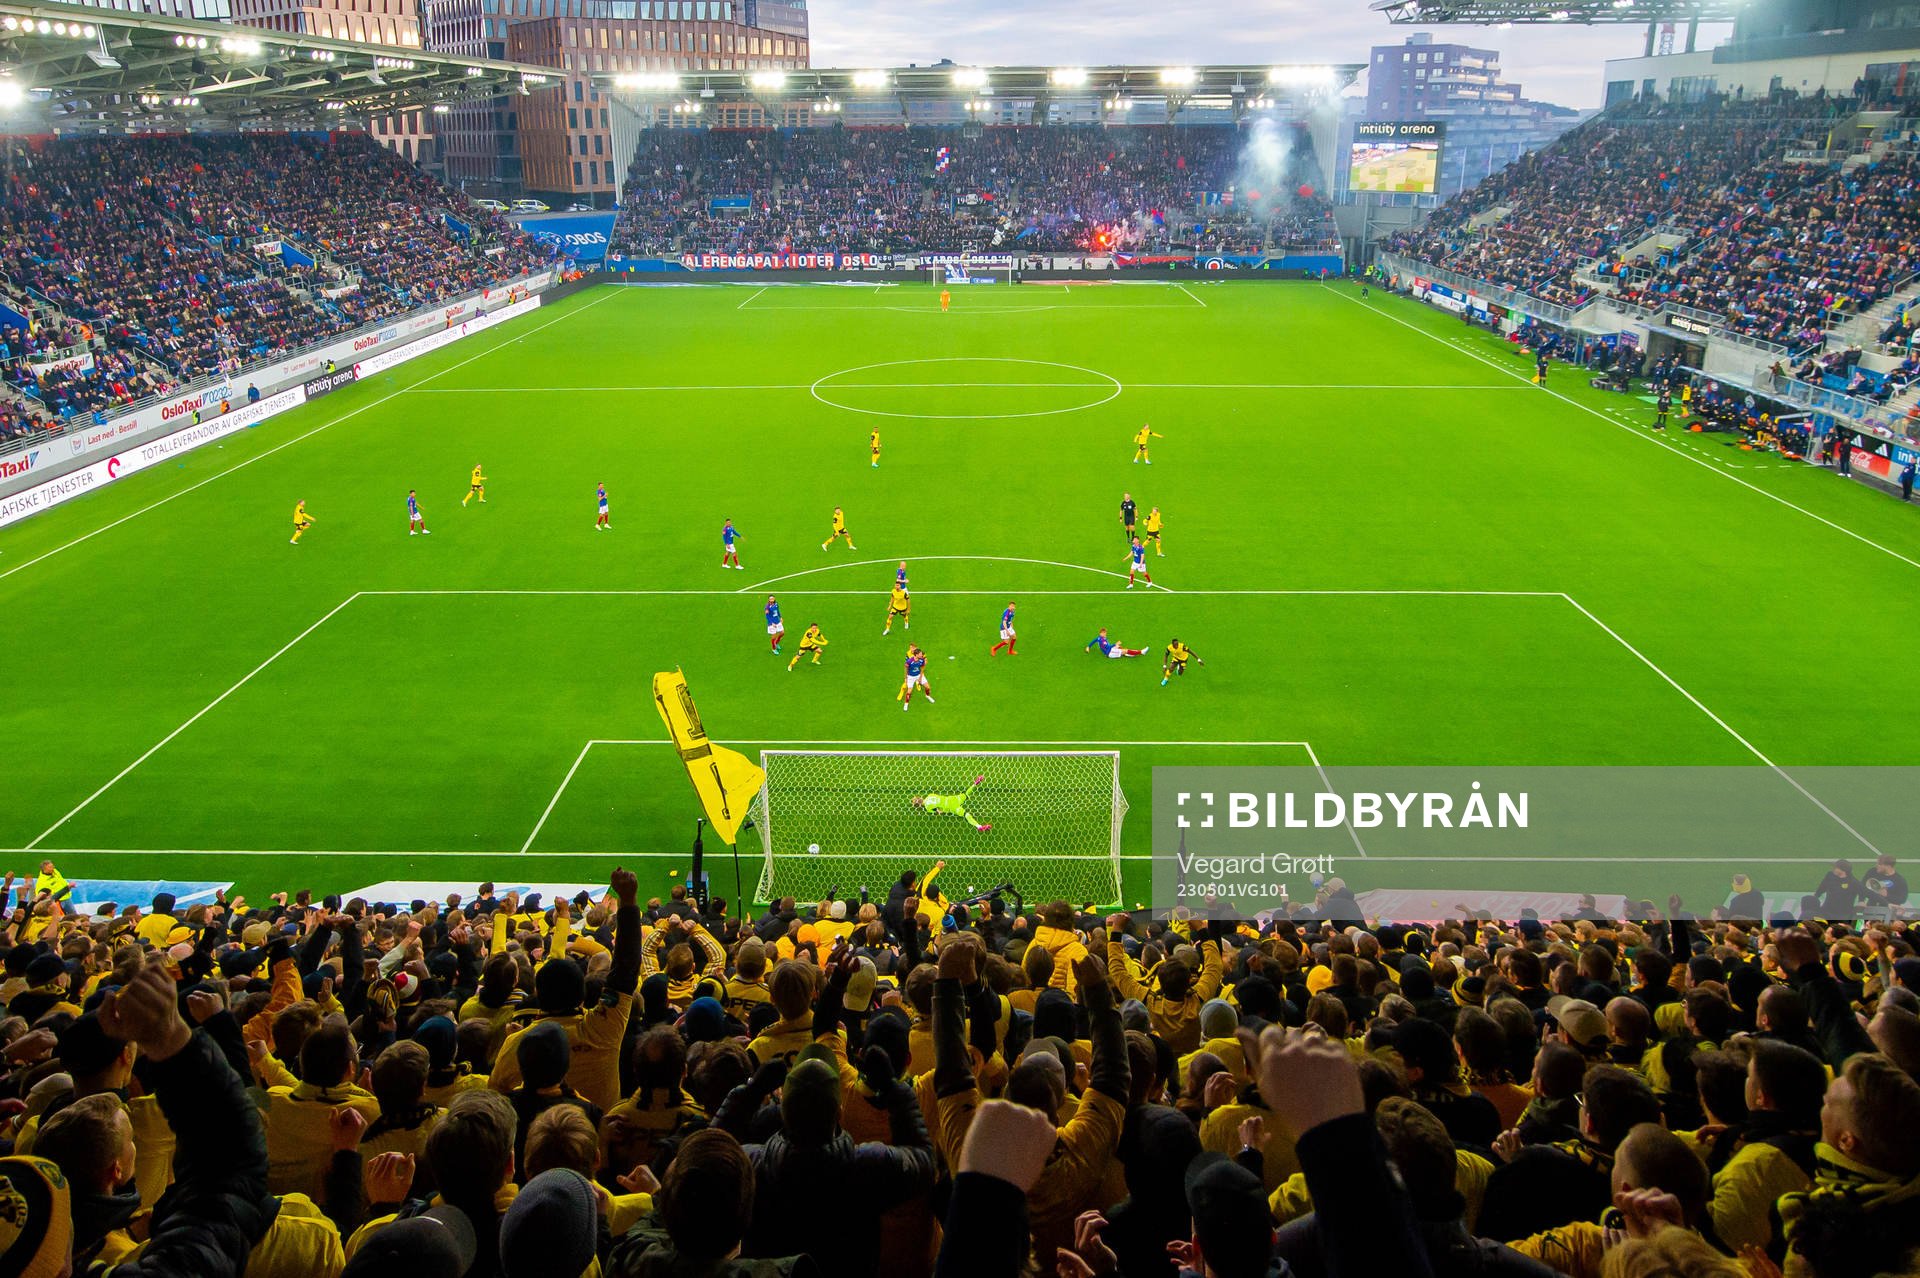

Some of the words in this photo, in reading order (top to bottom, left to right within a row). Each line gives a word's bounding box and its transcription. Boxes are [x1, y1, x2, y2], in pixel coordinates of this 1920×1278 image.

[1359, 122, 1396, 136] intility
[1400, 125, 1435, 134] arena
[842, 255, 878, 268] OSLO
[353, 334, 379, 351] OsloTaxi
[306, 375, 332, 396] intility
[332, 369, 354, 387] arena
[161, 395, 203, 421] OsloTaxi
[87, 434, 102, 445] Last
[101, 428, 115, 440] ned
[118, 420, 138, 434] Bestill
[141, 422, 220, 461] TOTALLEVERANDØR
[221, 418, 232, 429] AV
[232, 404, 264, 427] GRAFISKE
[264, 392, 297, 414] TJENESTER
[0, 454, 30, 479] Taxi
[0, 493, 39, 519] AFISKE
[40, 471, 94, 503] TJENESTER
